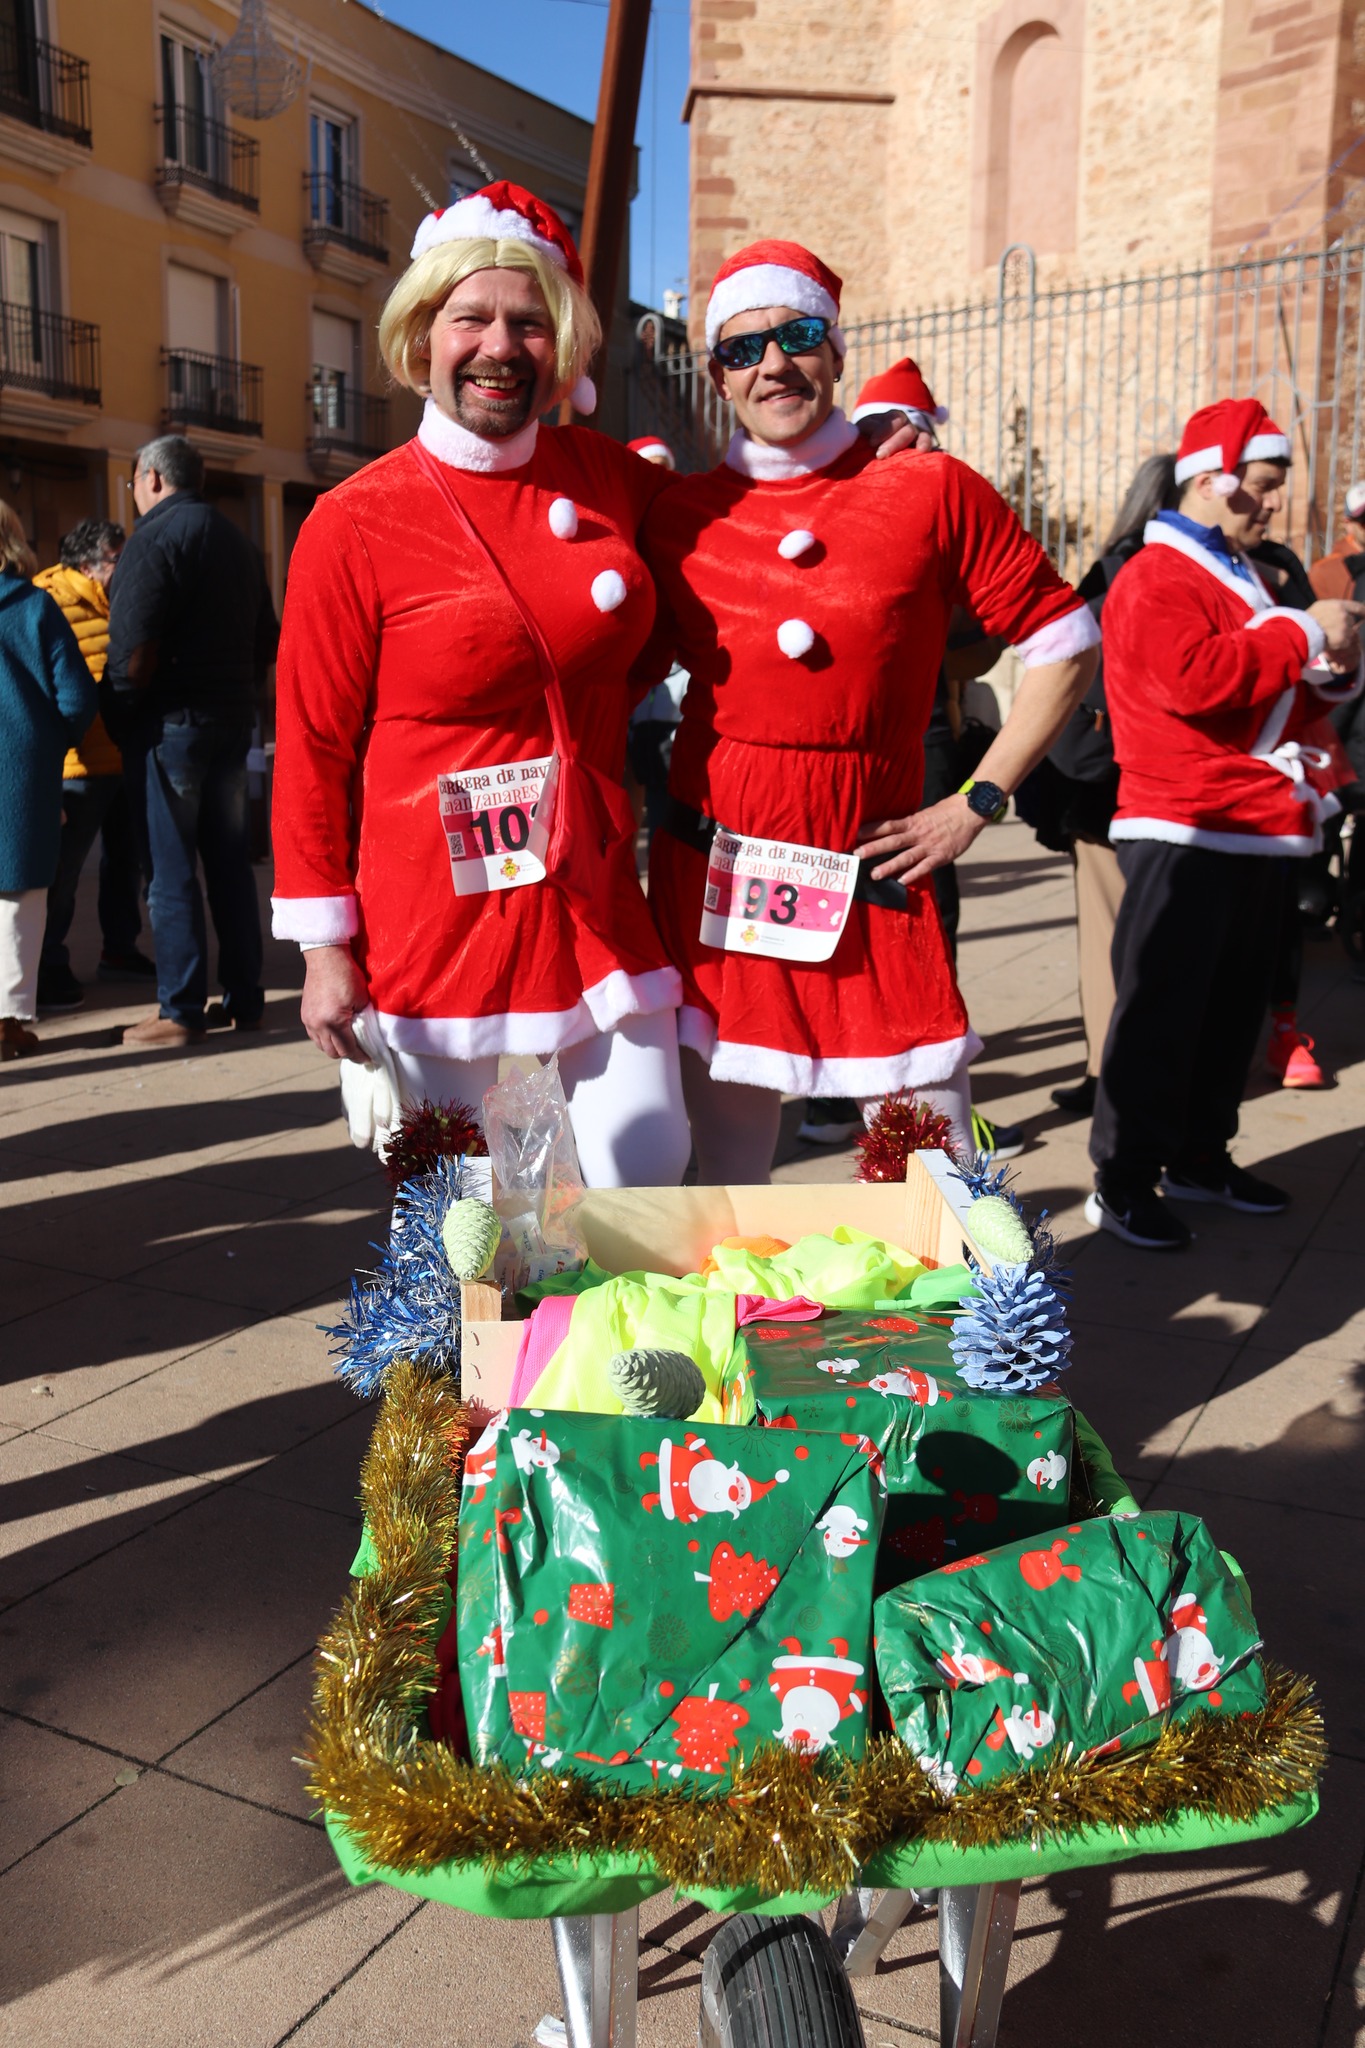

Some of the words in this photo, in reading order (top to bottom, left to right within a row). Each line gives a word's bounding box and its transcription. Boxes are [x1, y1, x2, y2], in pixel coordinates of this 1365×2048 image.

[471, 803, 538, 856] 10
[743, 878, 798, 925] 93
[809, 867, 848, 892] 2024
